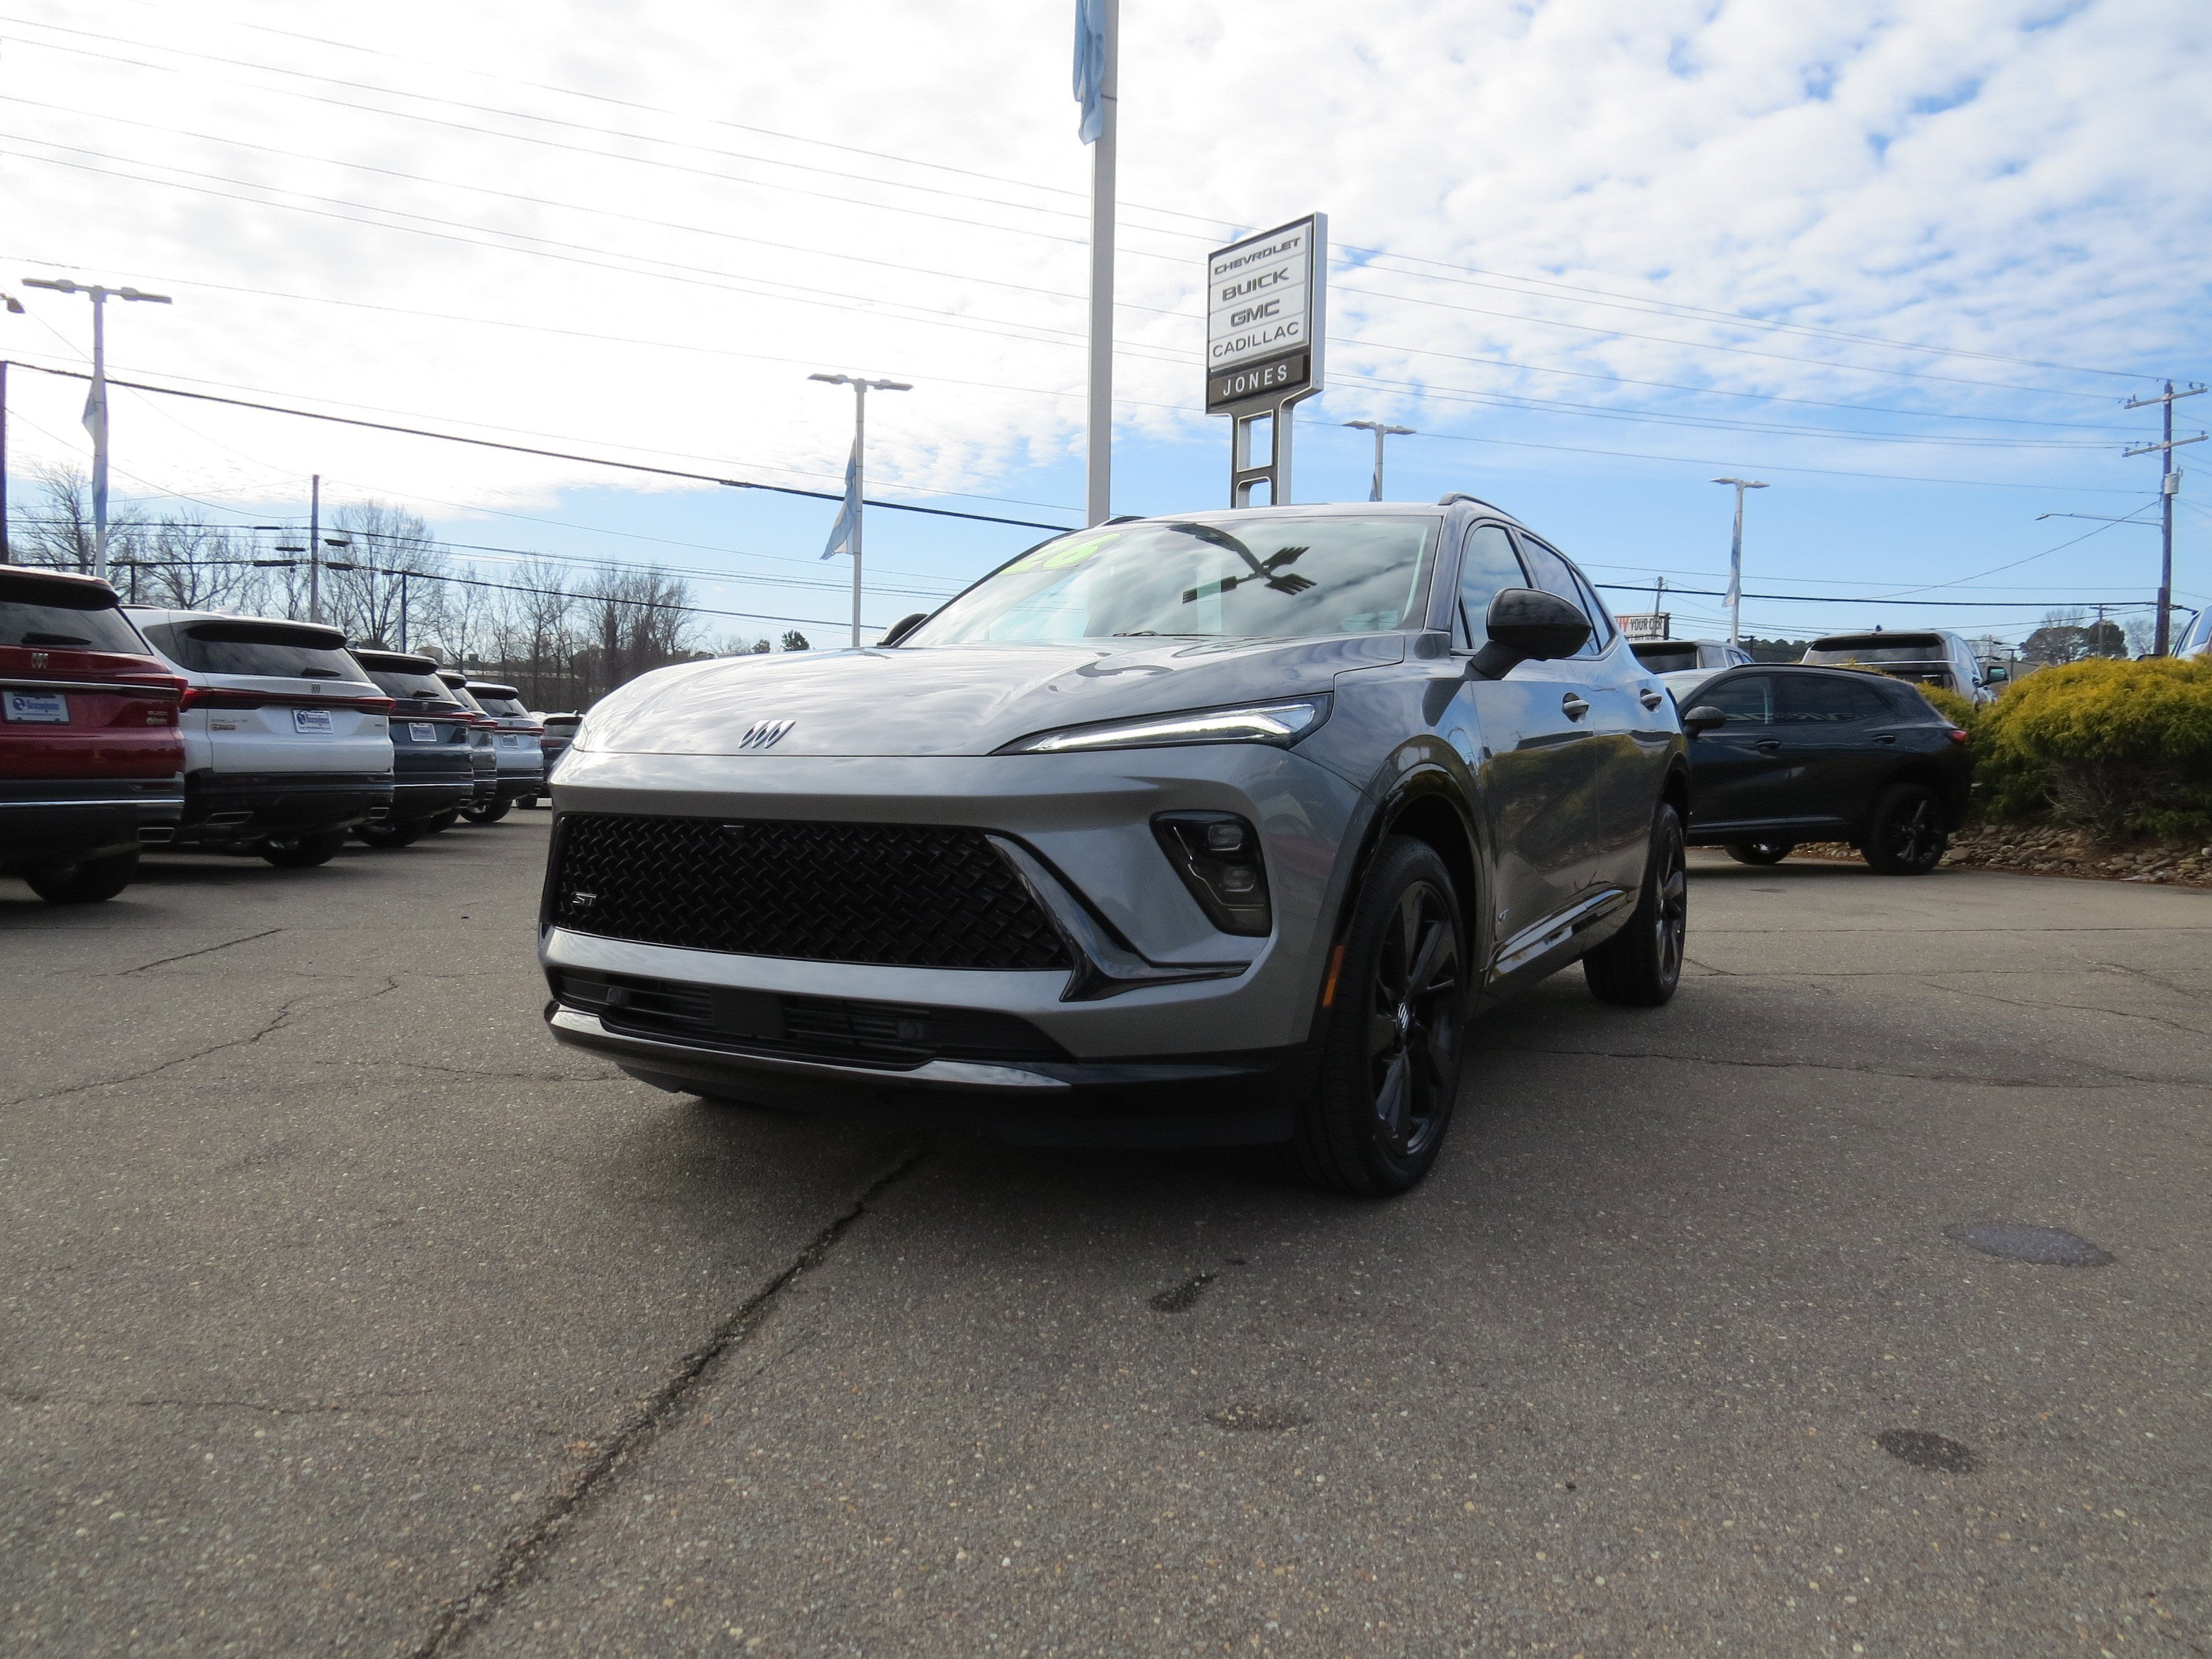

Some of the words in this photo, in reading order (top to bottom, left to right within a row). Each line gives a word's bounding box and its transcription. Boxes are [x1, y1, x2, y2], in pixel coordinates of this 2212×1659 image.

[1214, 237, 1301, 275] CHEVROLET
[1222, 268, 1289, 301] BUICK
[1231, 299, 1280, 327] GMC
[1213, 322, 1299, 357] CADILLAC
[1223, 364, 1287, 396] JONES
[1630, 618, 1647, 630] YOUR
[1649, 618, 1662, 630] CR
